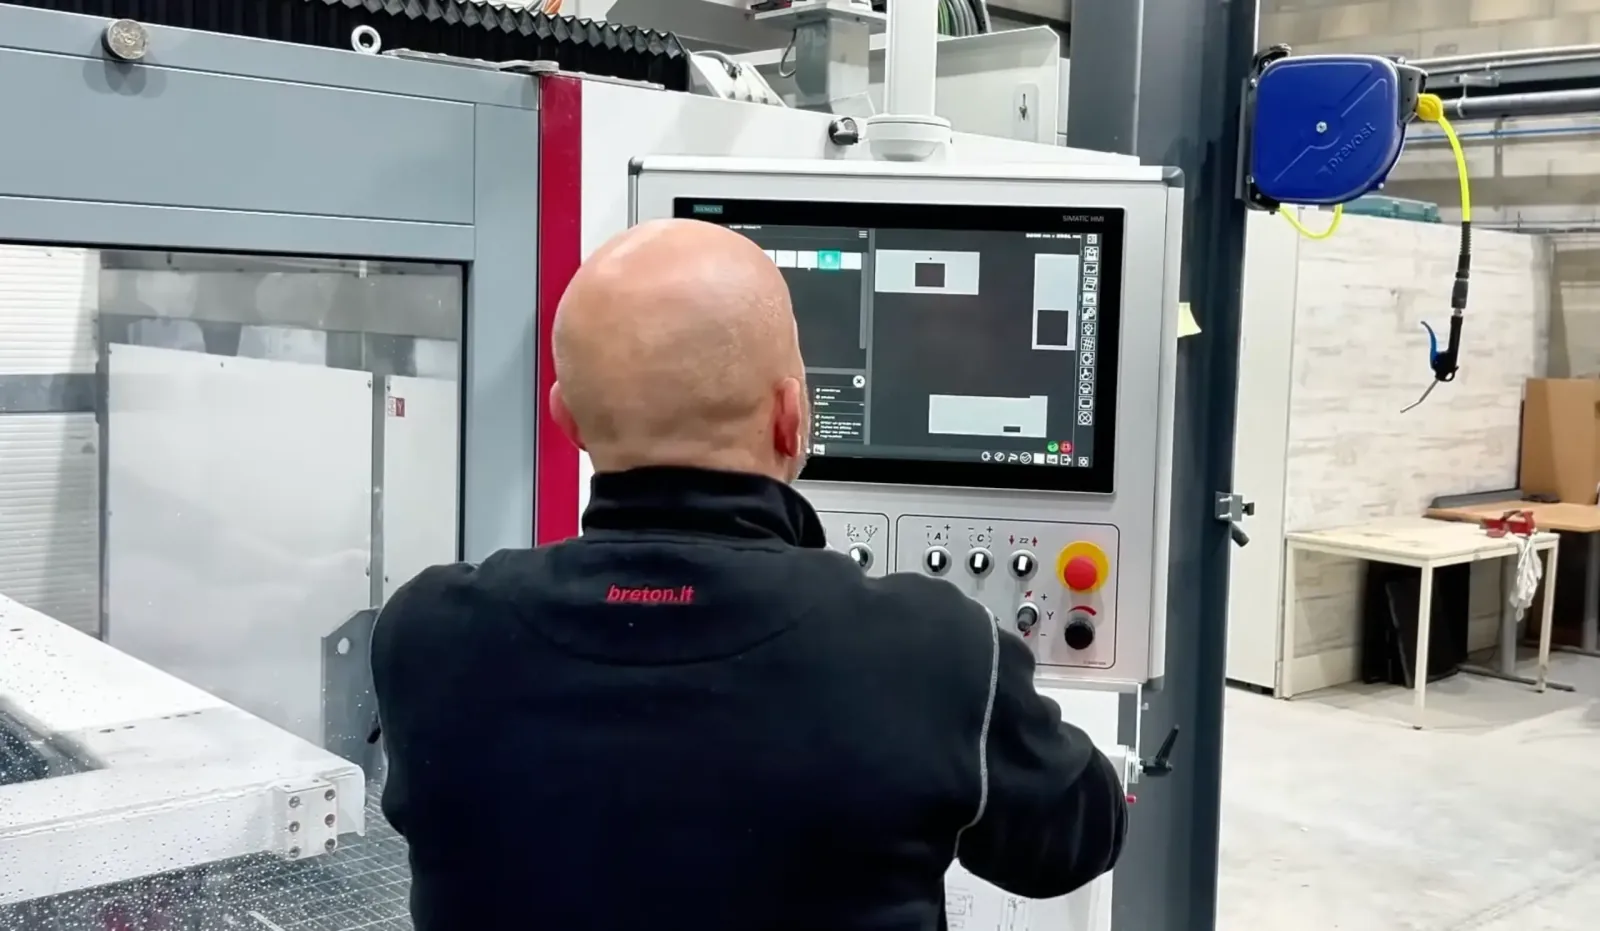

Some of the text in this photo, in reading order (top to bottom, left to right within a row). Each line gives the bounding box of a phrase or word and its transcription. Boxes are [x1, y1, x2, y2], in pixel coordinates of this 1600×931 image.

[1327, 122, 1377, 173] prevost
[934, 532, 942, 541] A
[976, 534, 985, 543] C
[1046, 611, 1055, 620] Y
